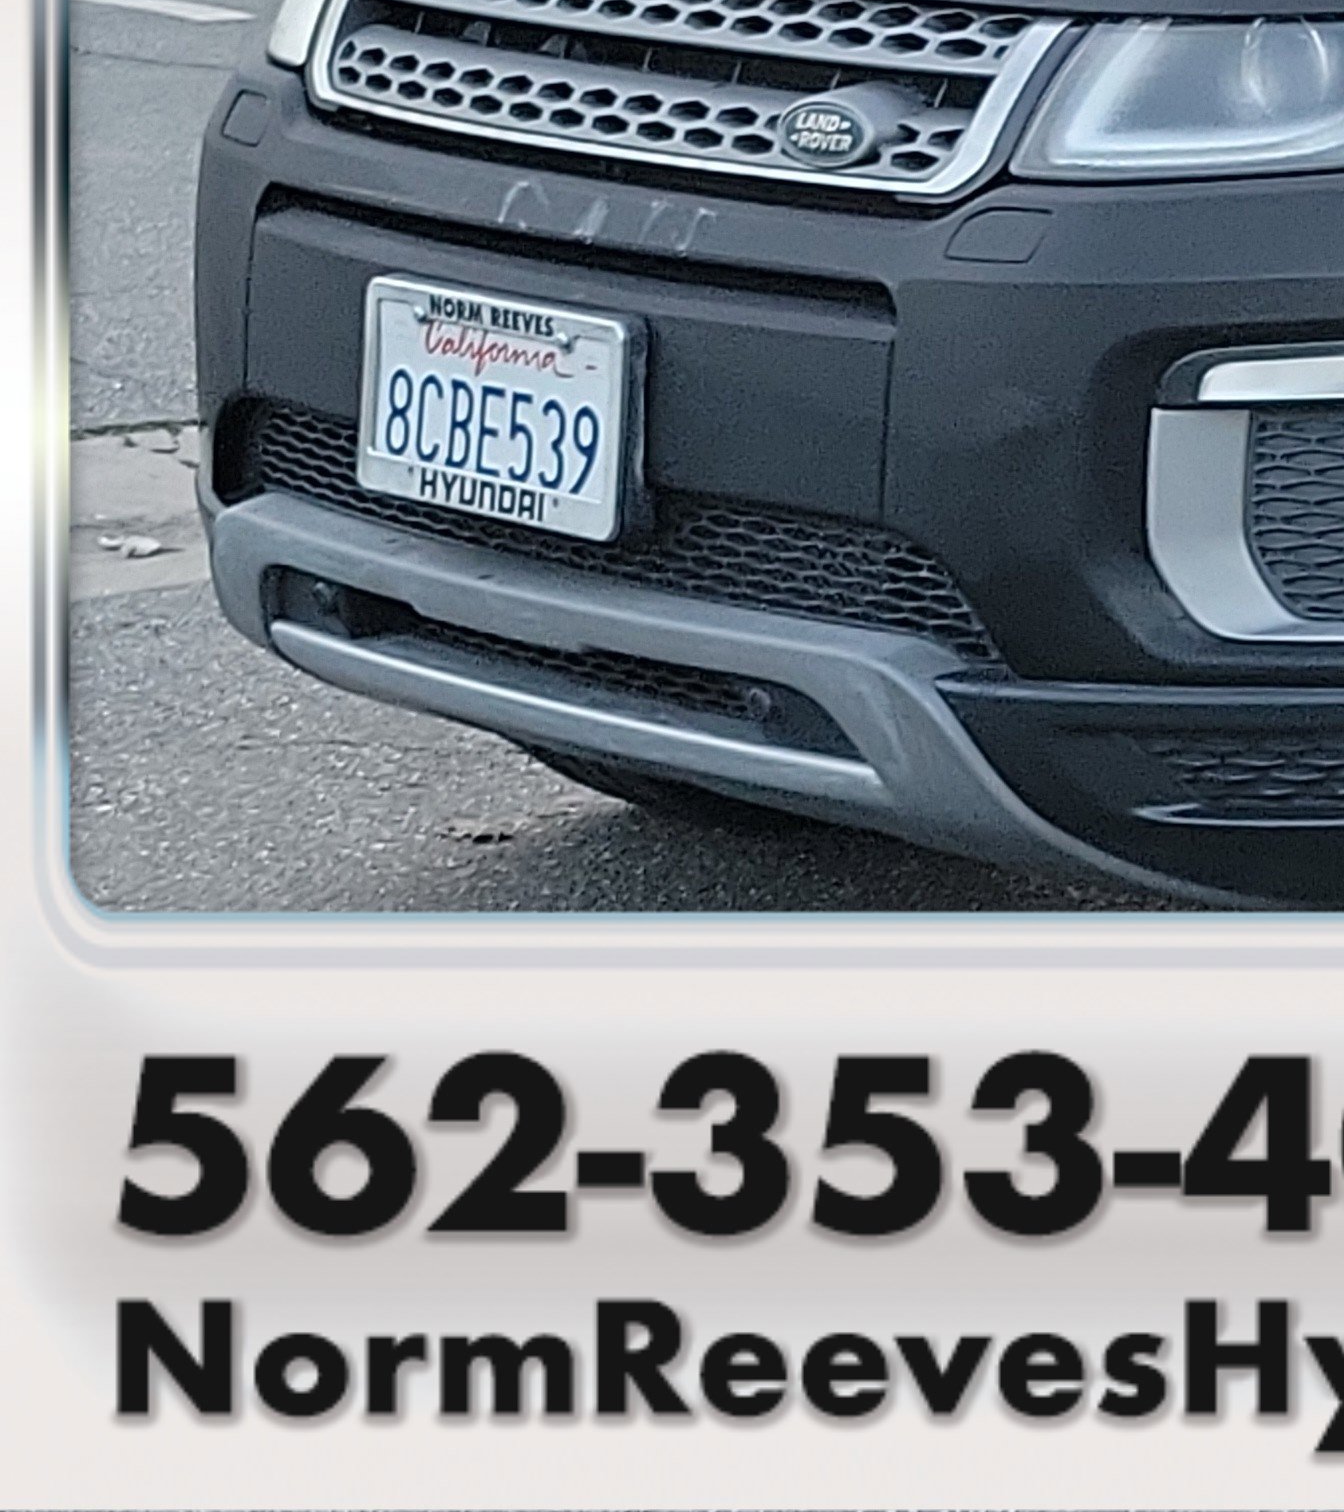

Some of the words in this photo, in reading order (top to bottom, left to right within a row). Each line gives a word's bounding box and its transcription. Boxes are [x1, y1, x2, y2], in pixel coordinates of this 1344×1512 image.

[795, 112, 841, 132] LAND
[798, 132, 853, 152] ROVER
[429, 294, 484, 325] NORM
[491, 306, 555, 336] REEVES
[425, 319, 574, 378] California
[385, 368, 601, 494] 8CBE539
[420, 468, 545, 522] HYUNDAI
